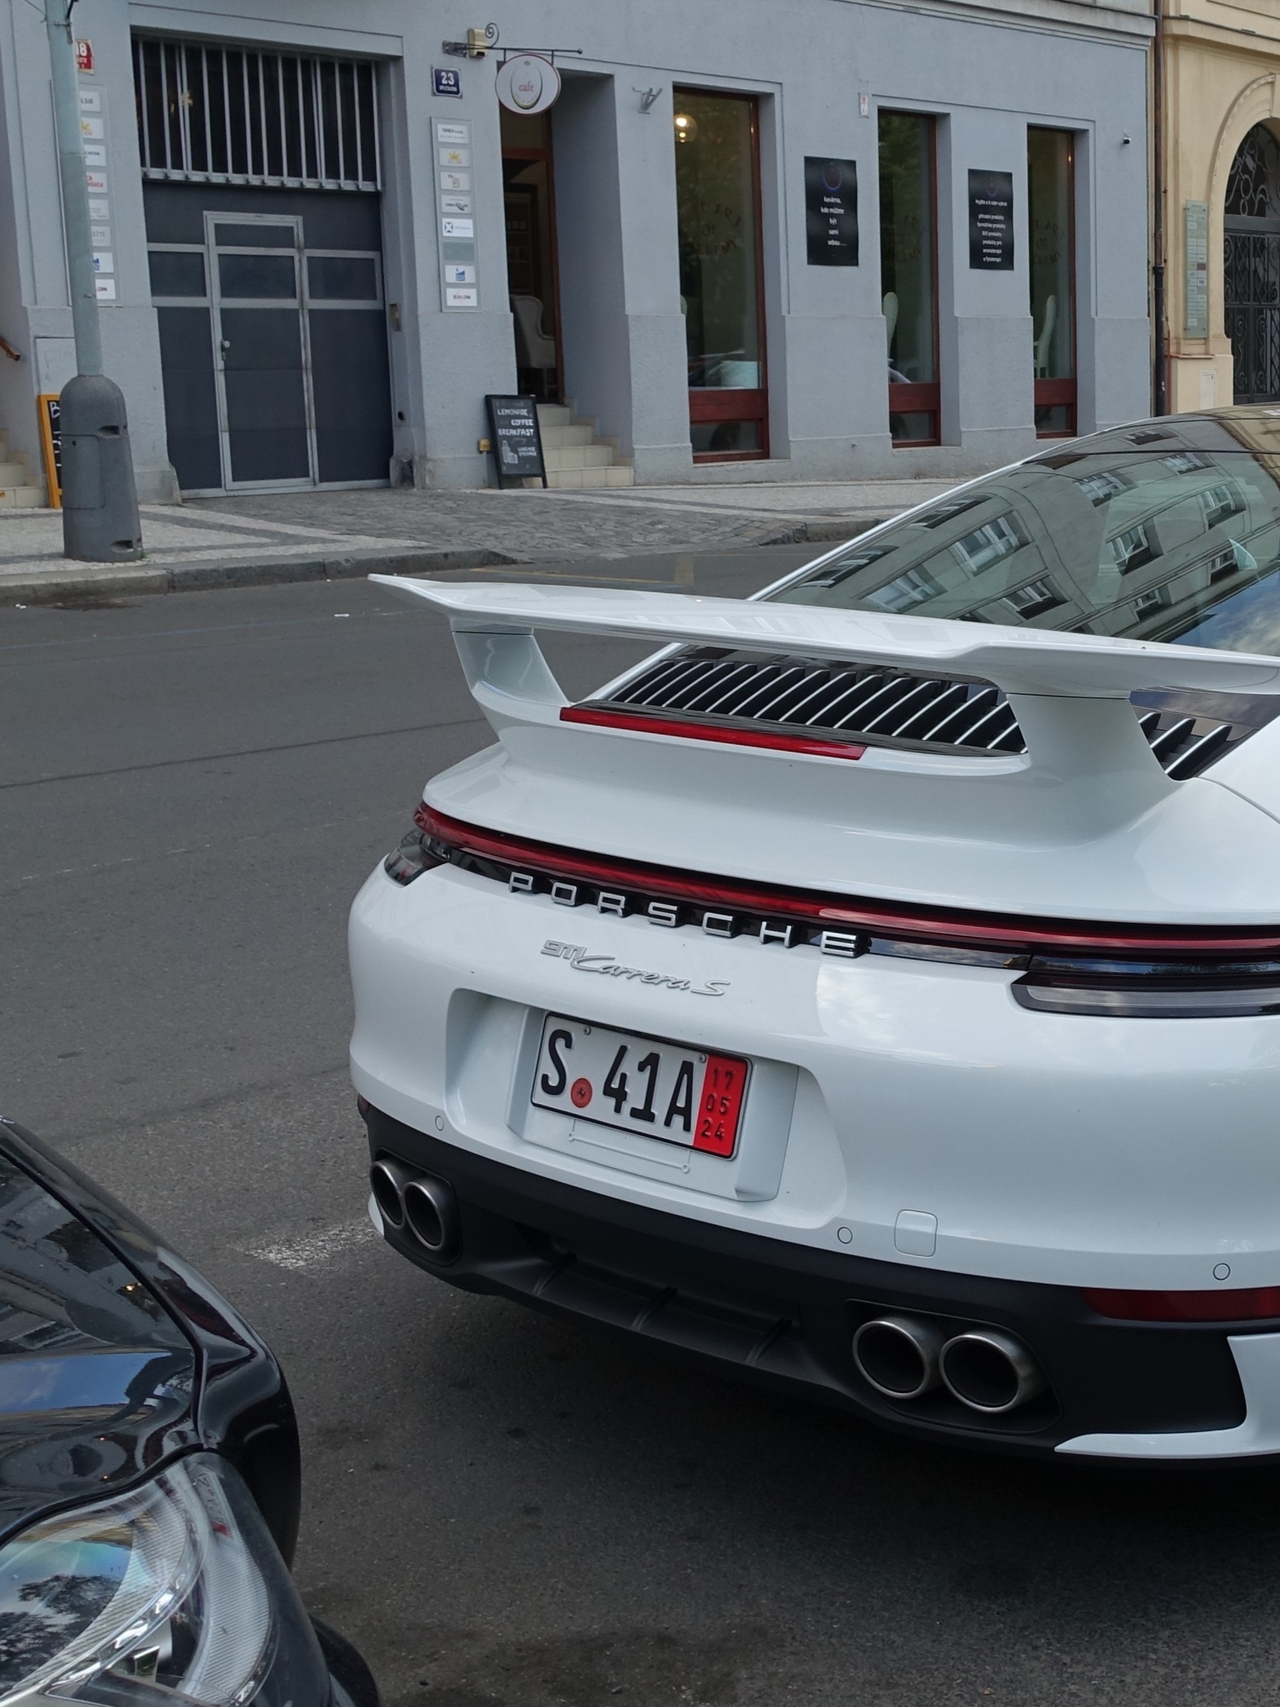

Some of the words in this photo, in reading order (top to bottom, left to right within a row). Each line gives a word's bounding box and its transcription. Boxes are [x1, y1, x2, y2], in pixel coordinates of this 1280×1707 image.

[440, 71, 456, 86] 23
[518, 81, 535, 93] cafe
[508, 871, 859, 958] PORSCHE
[540, 939, 588, 961] 911
[570, 954, 691, 992] Carrera
[690, 978, 732, 996] S
[541, 1029, 573, 1096] S
[603, 1044, 694, 1132] 41A
[712, 1067, 735, 1091] 17
[705, 1094, 732, 1115] 05
[700, 1118, 726, 1142] 24
